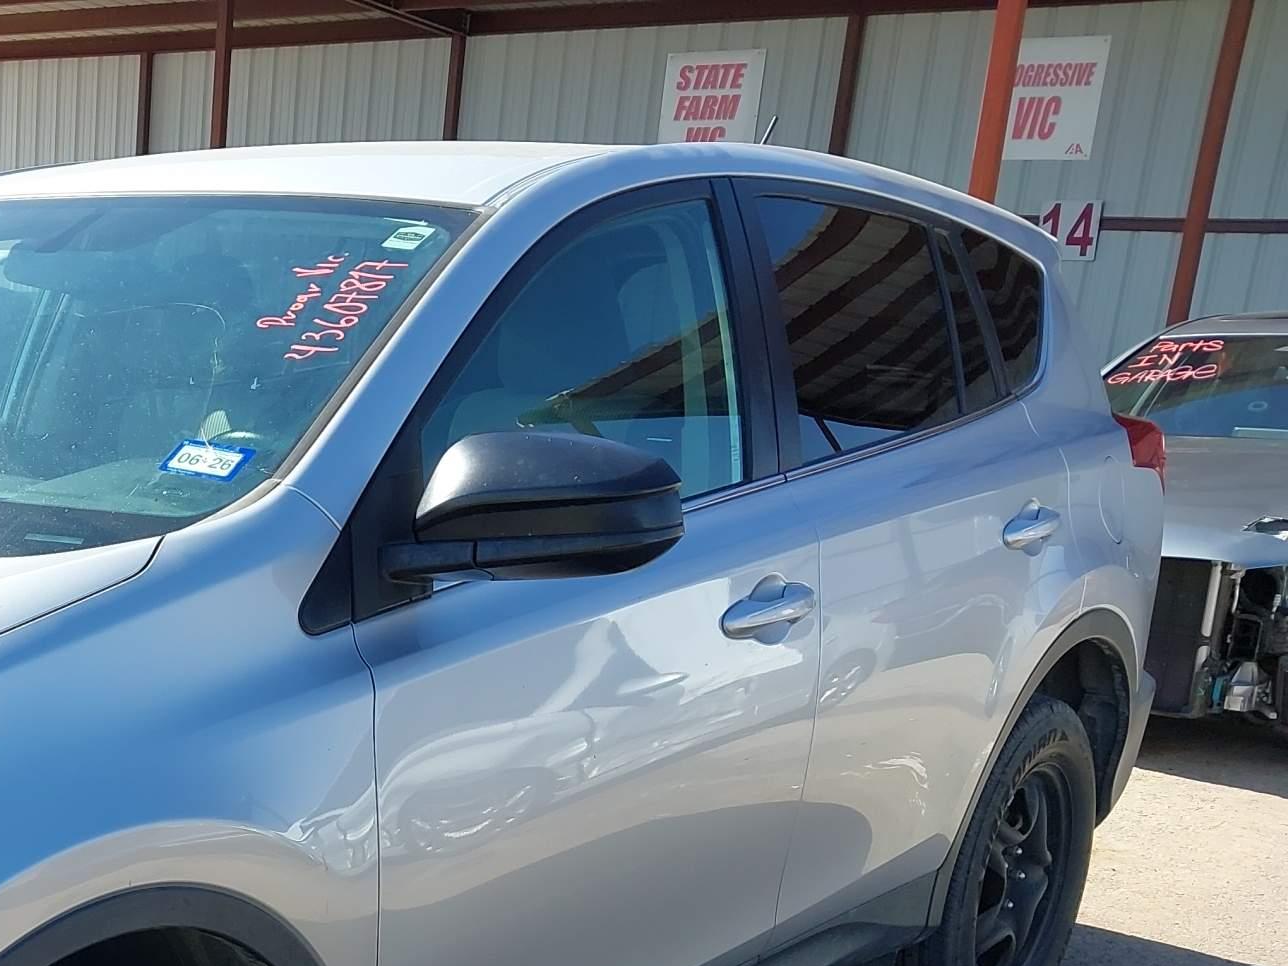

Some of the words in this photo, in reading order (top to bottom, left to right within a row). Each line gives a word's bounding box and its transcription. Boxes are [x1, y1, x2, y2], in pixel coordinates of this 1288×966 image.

[676, 63, 748, 91] STATE
[1014, 62, 1098, 87] OGRESSIVE
[673, 94, 742, 121] FARM
[1012, 96, 1062, 140] VIC
[685, 126, 726, 143] VIC
[1042, 202, 1094, 257] 14
[283, 259, 409, 360] 43607817
[1128, 352, 1183, 369] IN
[177, 452, 203, 466] 06
[208, 457, 234, 471] 26
